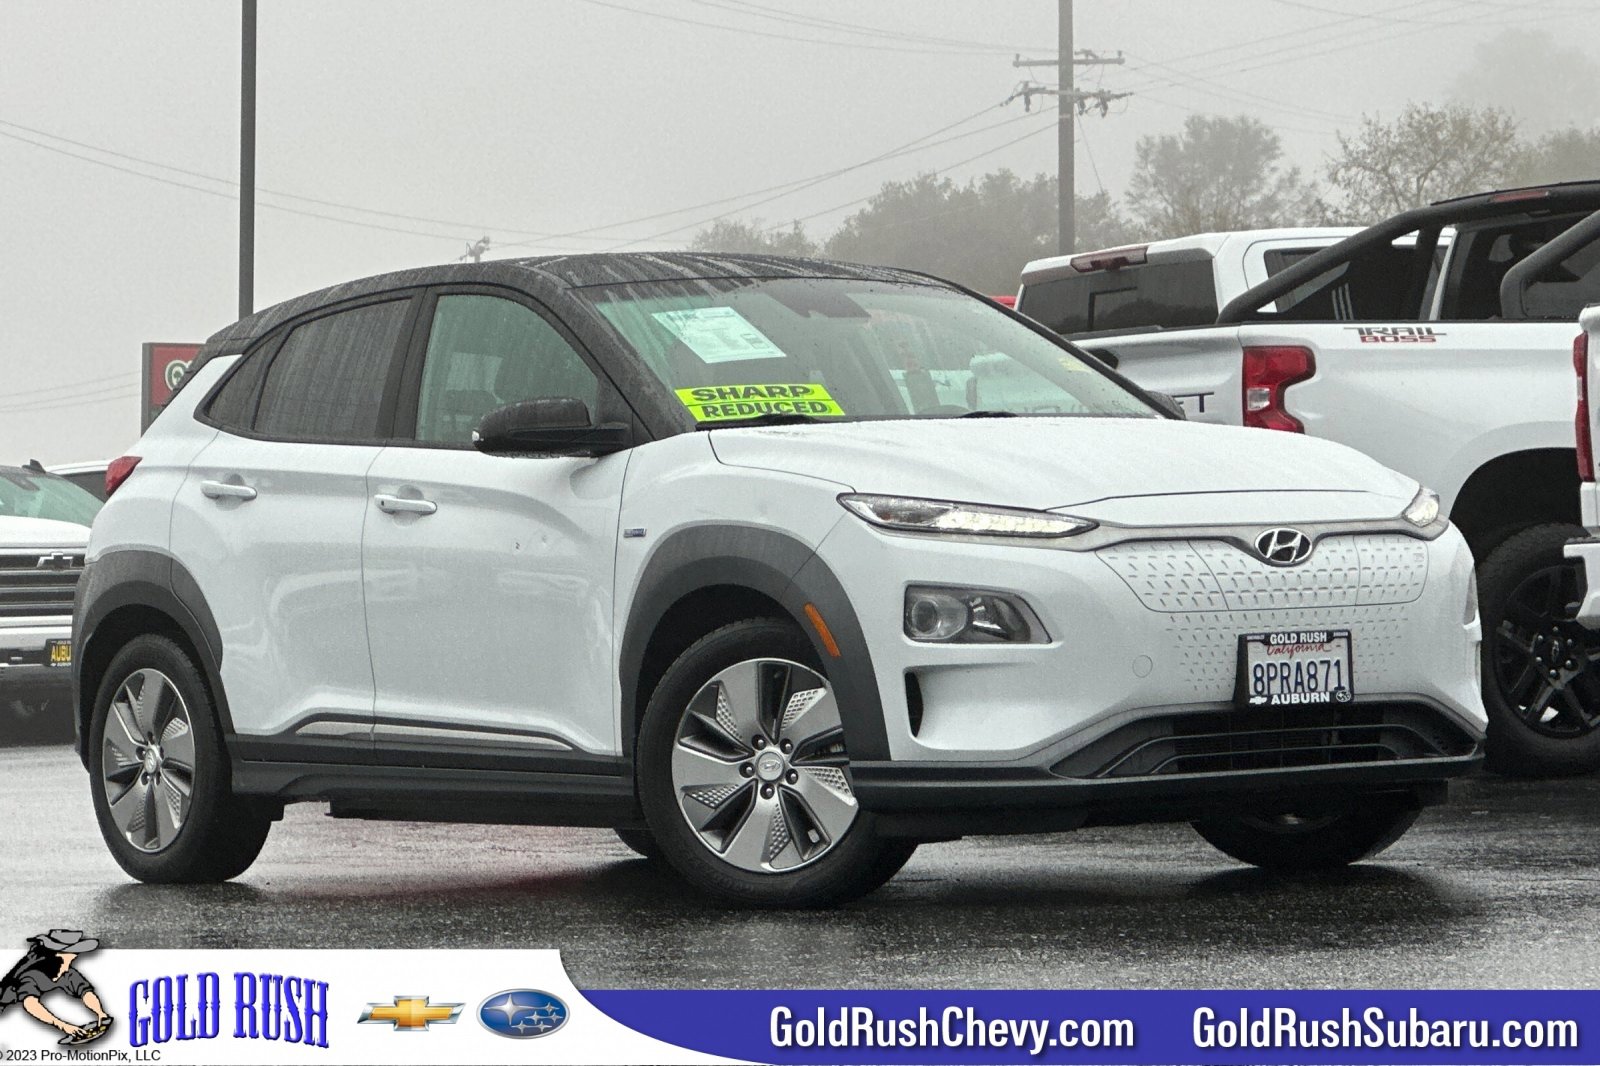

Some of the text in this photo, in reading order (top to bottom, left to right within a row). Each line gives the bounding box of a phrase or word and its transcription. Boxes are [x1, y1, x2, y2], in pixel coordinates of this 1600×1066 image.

[1343, 327, 1447, 336] TRAIL
[1360, 335, 1437, 343] BOSS
[690, 385, 815, 402] SHARP
[701, 401, 832, 418] REDUCED
[1269, 633, 1298, 645] GOLD
[1299, 631, 1327, 643] RUSH
[1266, 642, 1331, 659] California
[1252, 659, 1346, 696] 8PRA871
[1270, 691, 1331, 705] AUBURN
